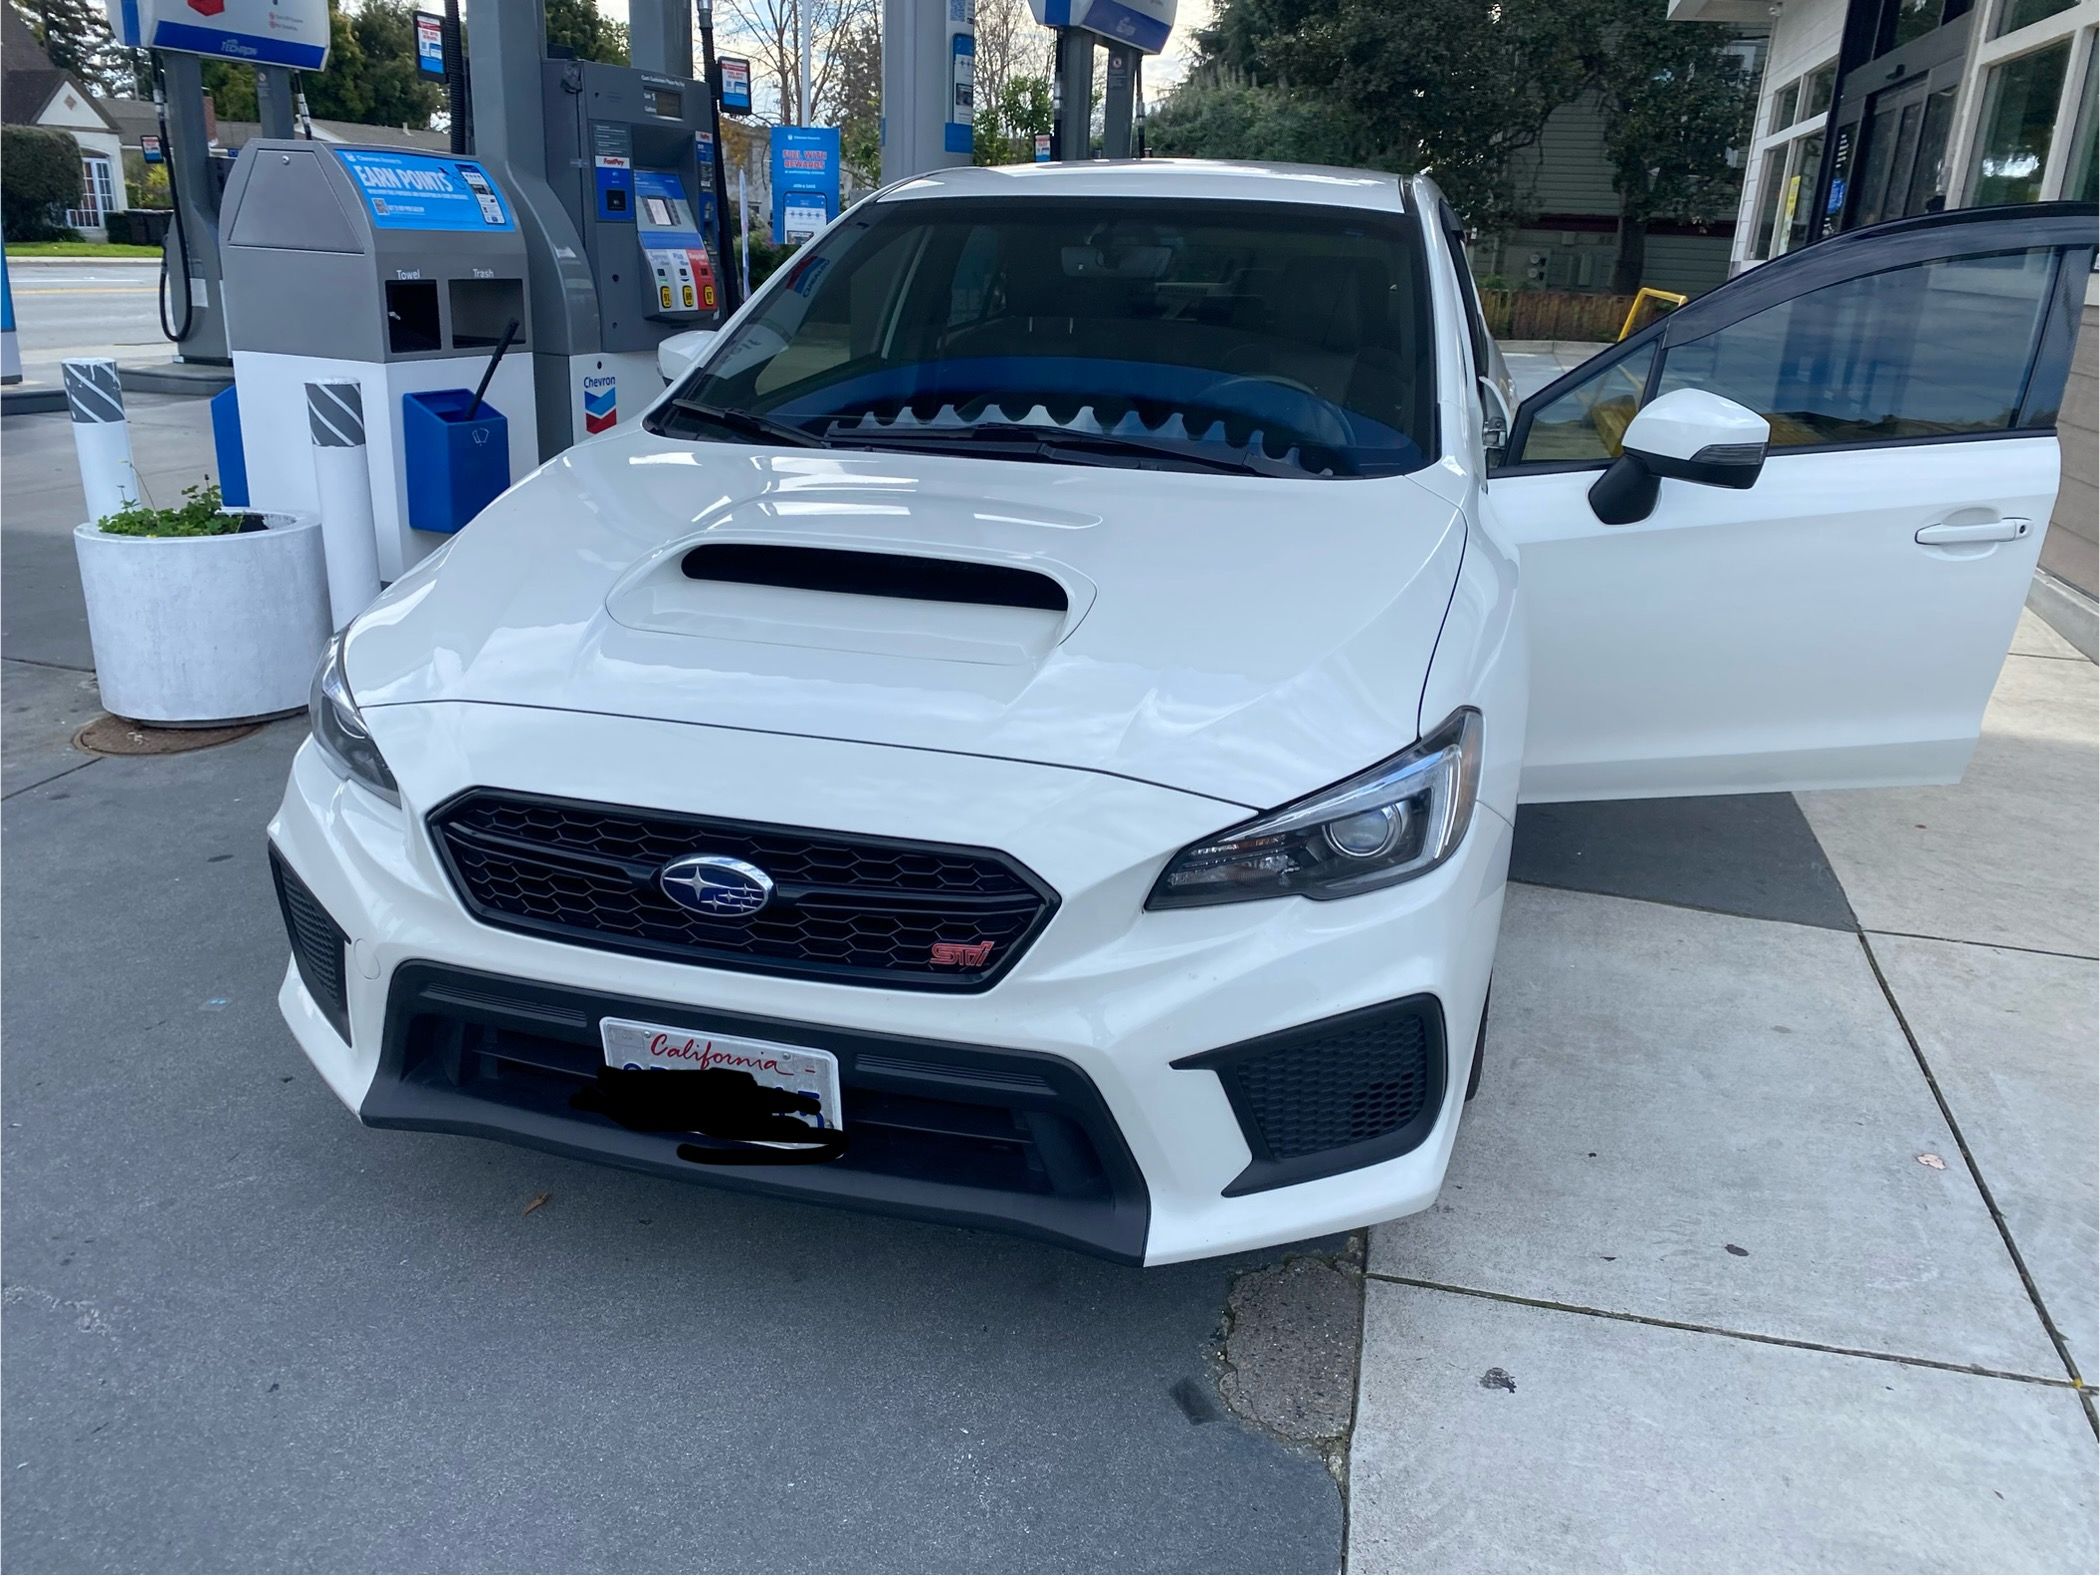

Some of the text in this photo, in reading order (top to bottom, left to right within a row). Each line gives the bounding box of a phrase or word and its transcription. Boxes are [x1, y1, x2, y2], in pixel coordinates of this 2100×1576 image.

[352, 165, 454, 192] EARN POINTS
[396, 269, 420, 280] Towel
[472, 268, 494, 278] Trash
[583, 376, 616, 389] Chevron
[650, 1033, 794, 1071] California
